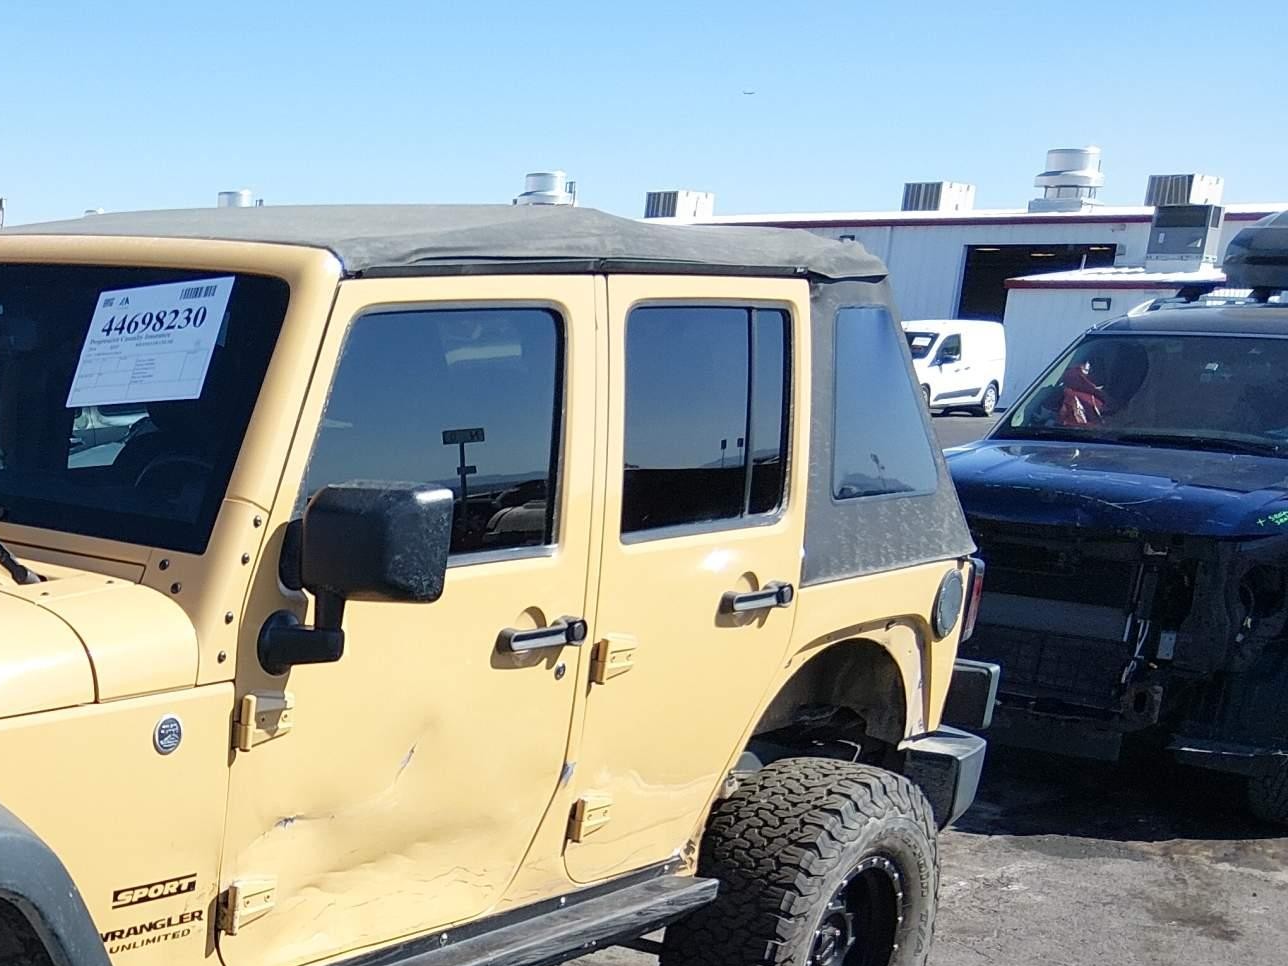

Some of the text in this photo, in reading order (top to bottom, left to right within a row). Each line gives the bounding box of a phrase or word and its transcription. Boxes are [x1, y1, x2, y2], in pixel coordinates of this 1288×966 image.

[101, 306, 207, 337] 44698230
[115, 876, 196, 905] SPORT
[109, 928, 191, 955] UNLIMITED
